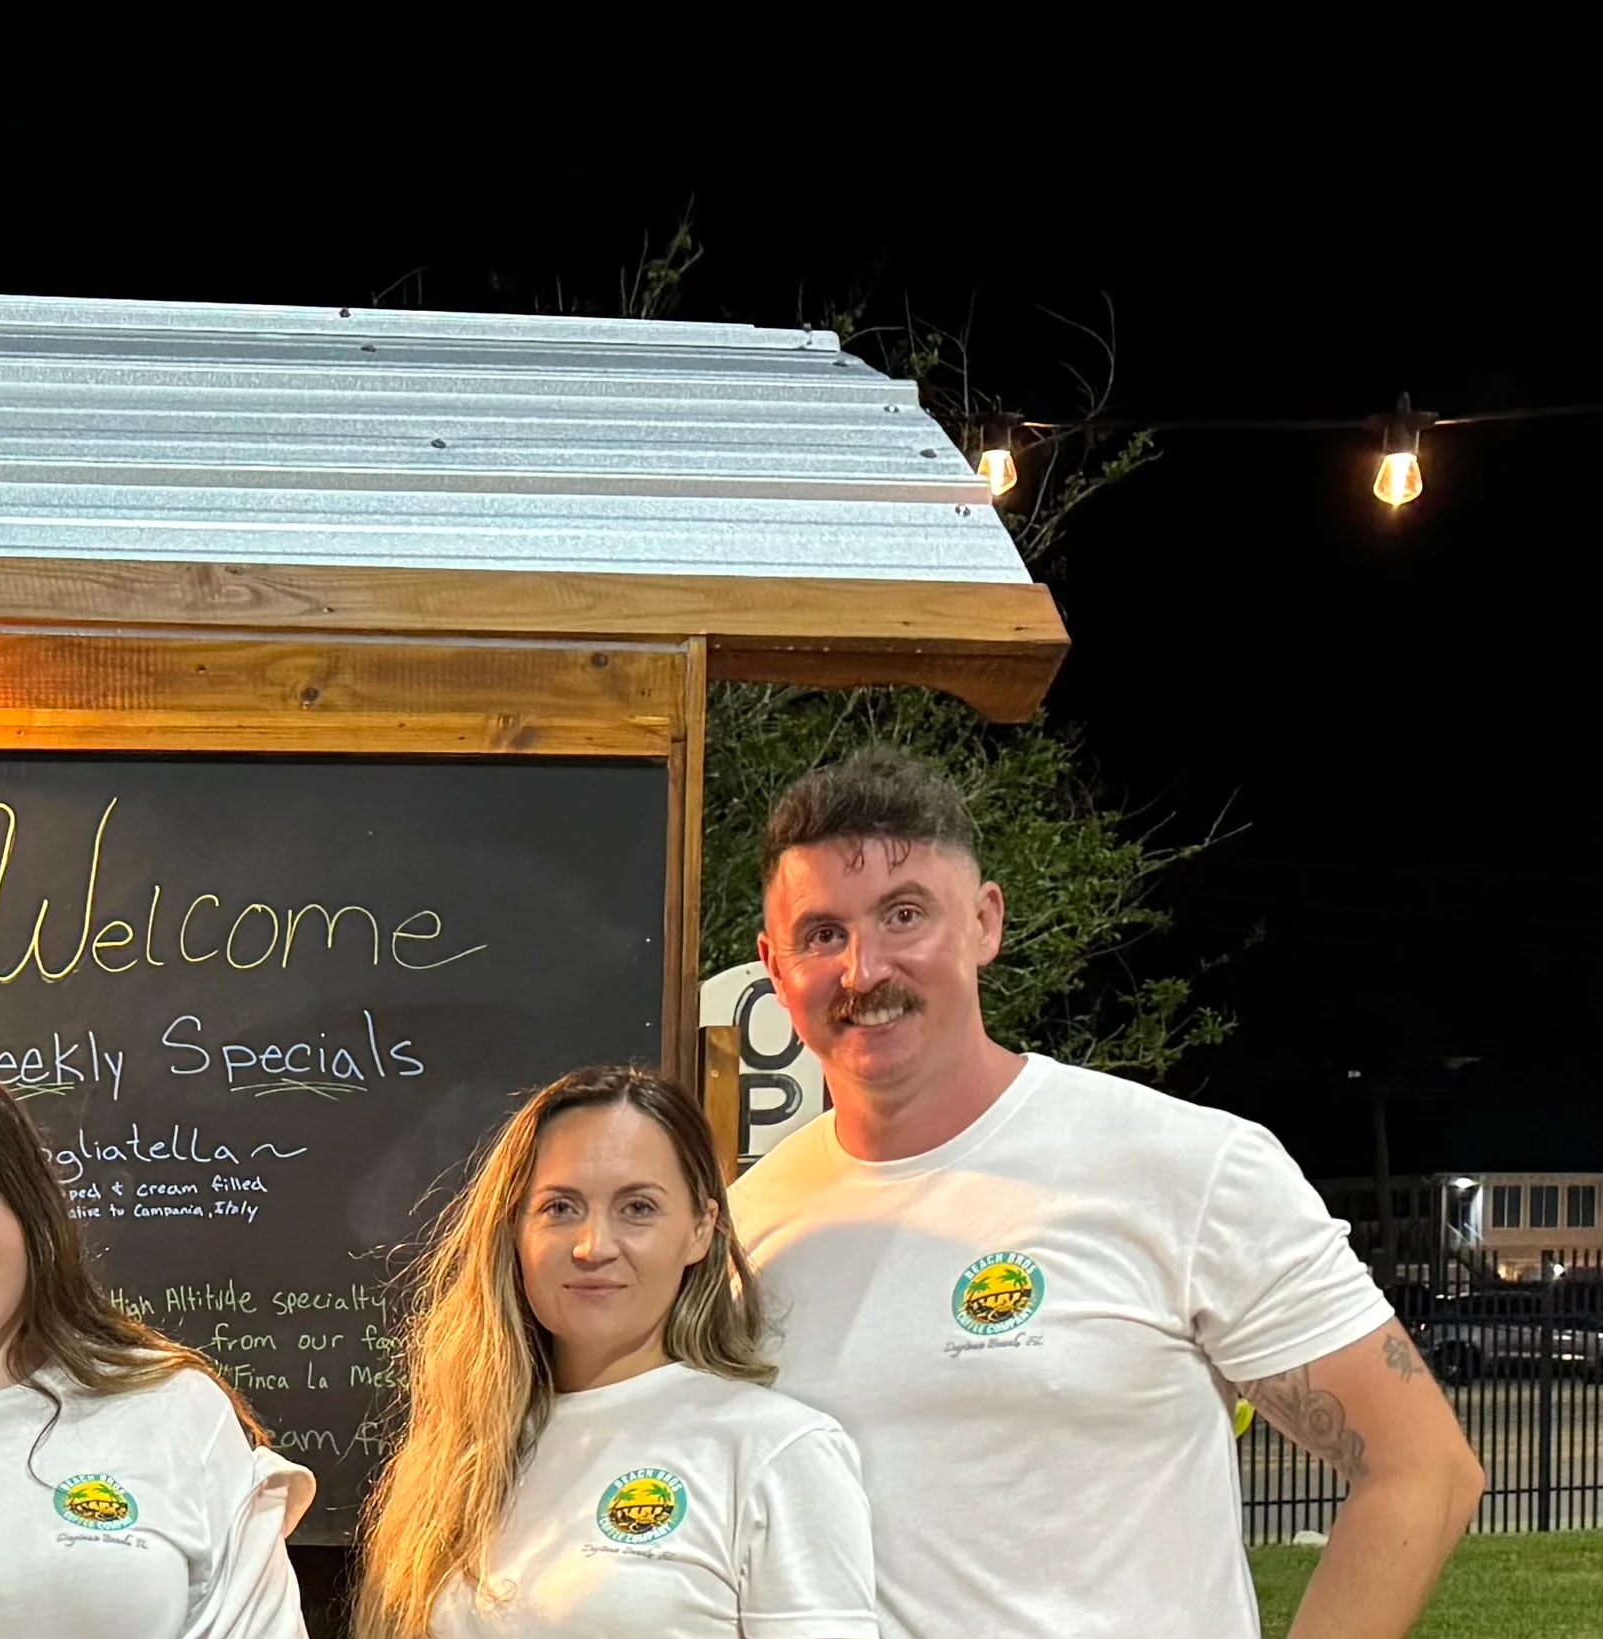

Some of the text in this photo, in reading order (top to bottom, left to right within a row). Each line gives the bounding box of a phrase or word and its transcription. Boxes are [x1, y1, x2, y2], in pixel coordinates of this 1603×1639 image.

[161, 1012, 427, 1086] Specials
[137, 1184, 198, 1197] cream
[211, 1174, 267, 1192] filled
[110, 1204, 124, 1217] to
[964, 1253, 1037, 1279] BEACH BROS
[111, 1288, 154, 1322] High
[166, 1279, 257, 1313] Altitude
[211, 1323, 277, 1351] from
[298, 1334, 344, 1350] our
[307, 1361, 329, 1389] La
[614, 1469, 682, 1492] BEACH BROS
